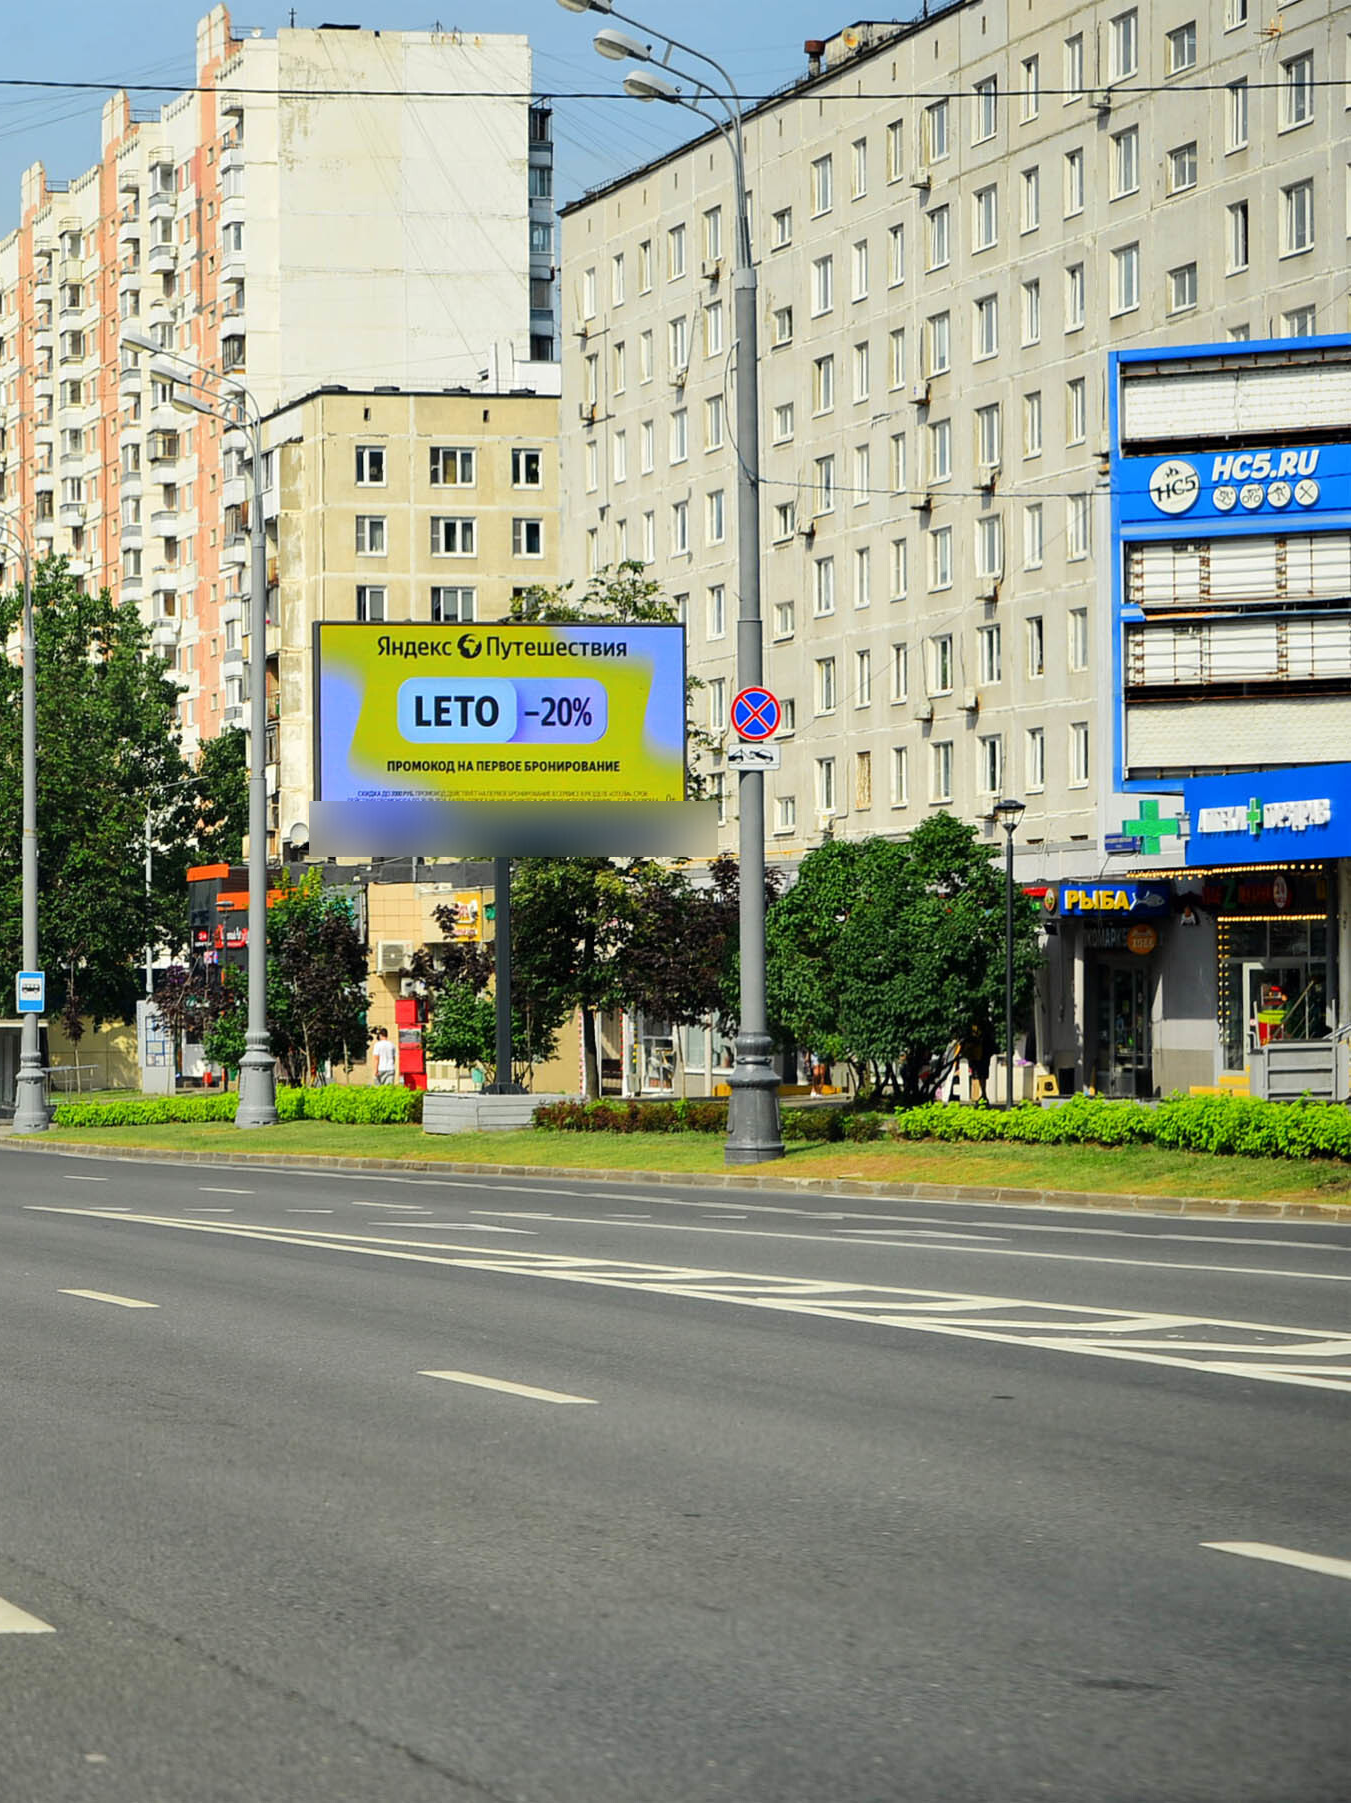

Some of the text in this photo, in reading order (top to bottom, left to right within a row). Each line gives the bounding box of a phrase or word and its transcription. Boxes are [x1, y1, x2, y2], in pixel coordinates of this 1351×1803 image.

[1211, 449, 1320, 482] HC5.RU
[1156, 474, 1197, 503] HC5
[377, 636, 628, 660] Яндекс Путешествия
[414, 695, 500, 728] LETO
[524, 696, 593, 727] -20%
[387, 760, 621, 774] ПРОМОКОД НА ПЕРВОЕ БРОНИРОВАНИЕ
[1064, 889, 1132, 911] РЫБА
